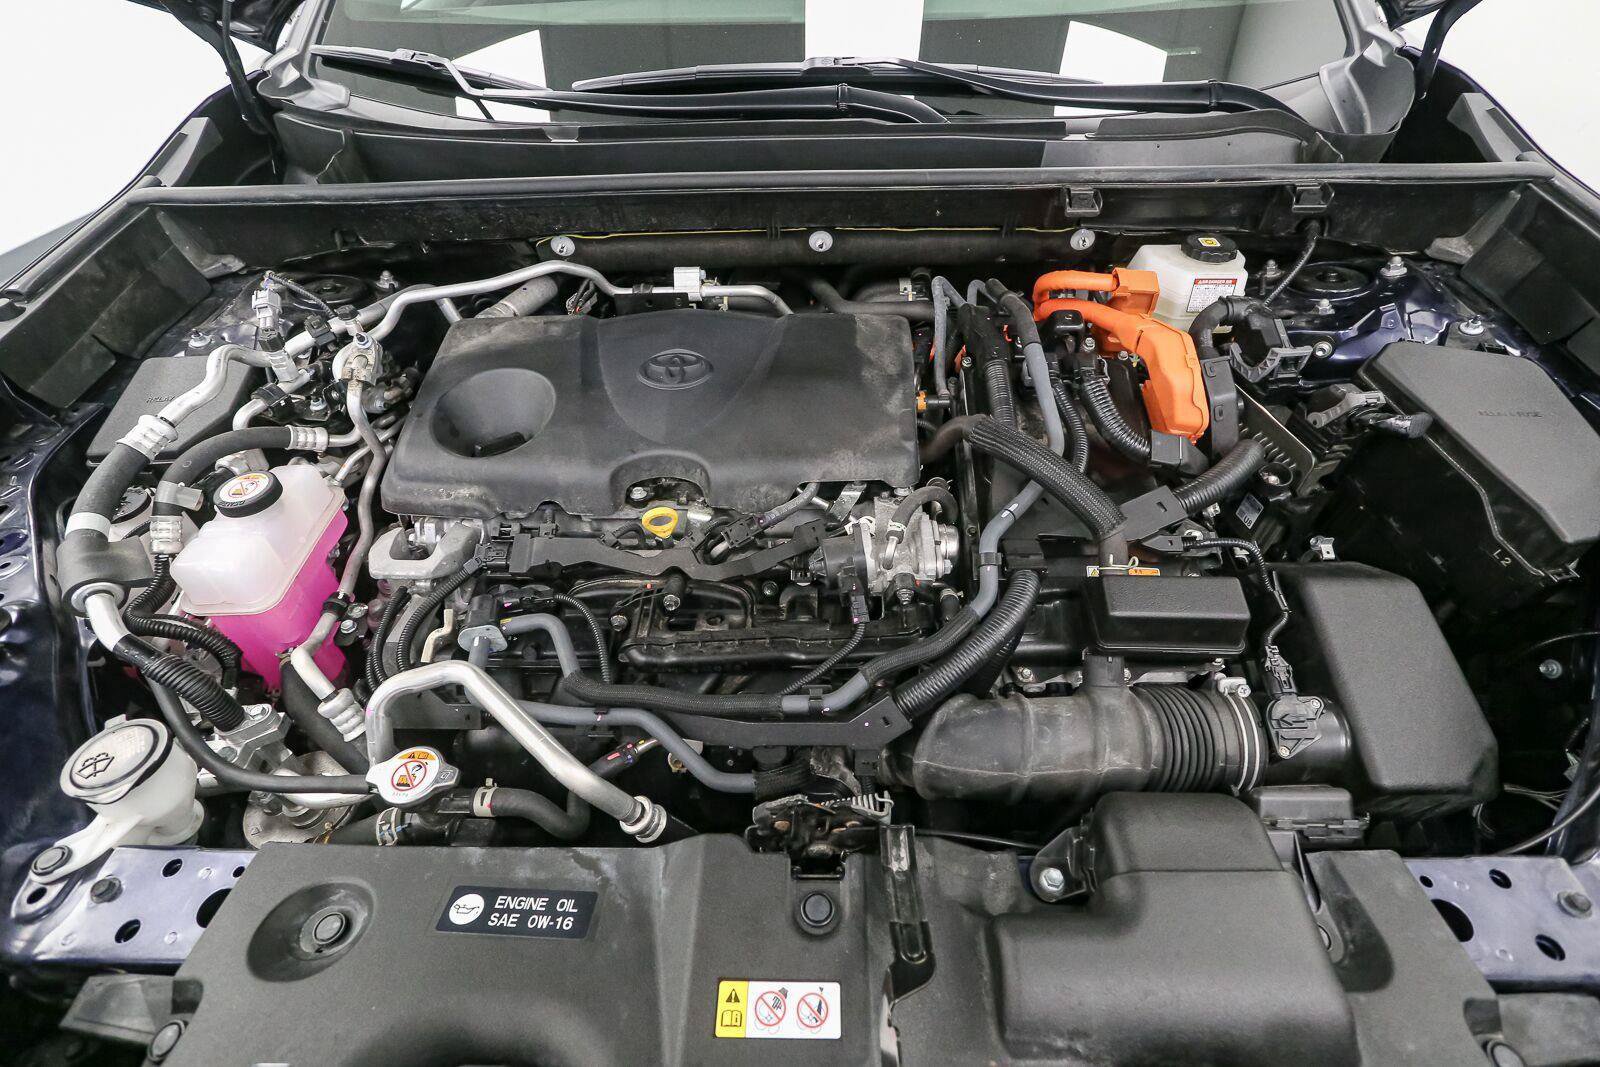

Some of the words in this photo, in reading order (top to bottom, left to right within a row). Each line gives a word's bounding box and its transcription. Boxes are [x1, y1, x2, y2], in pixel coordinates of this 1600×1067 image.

[494, 895, 549, 911] ENGINE
[556, 899, 578, 913] OIL
[488, 913, 520, 928] SAE
[527, 915, 574, 930] 0W-16
